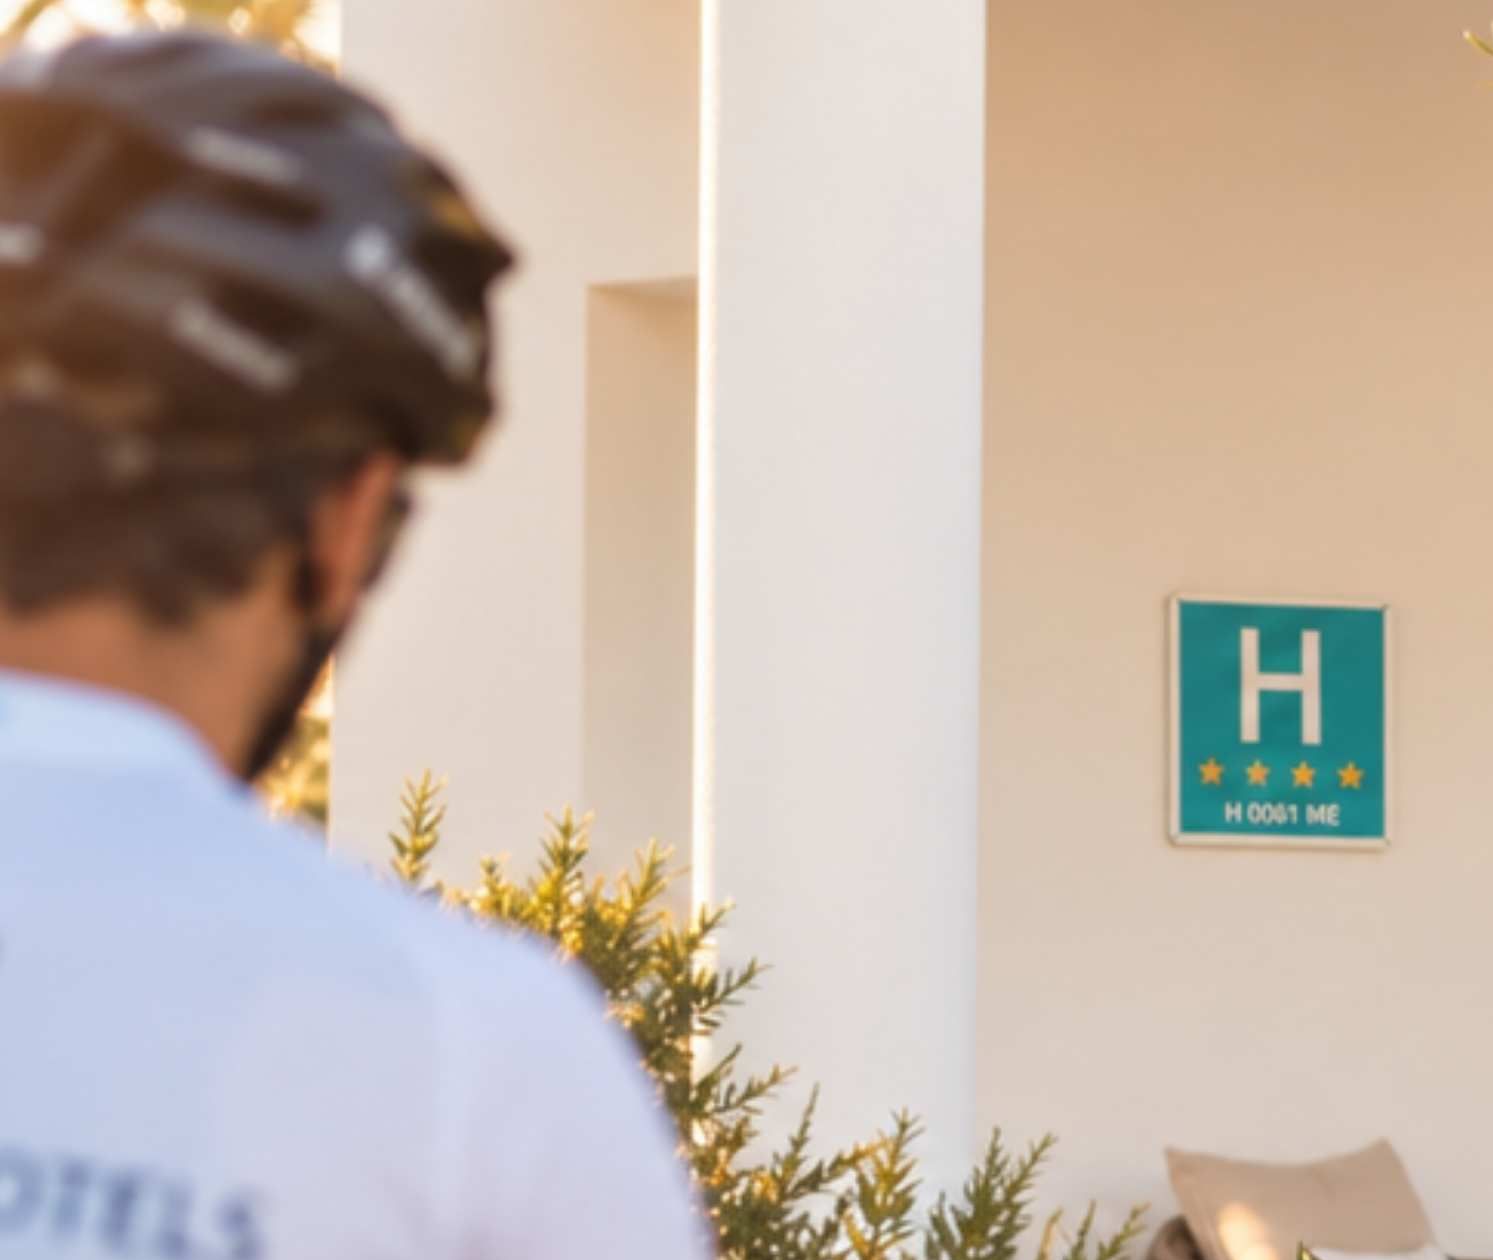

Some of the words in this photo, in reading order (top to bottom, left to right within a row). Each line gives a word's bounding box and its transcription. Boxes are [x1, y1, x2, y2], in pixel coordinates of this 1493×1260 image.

[1240, 627, 1322, 745] H
[1224, 801, 1243, 824] H
[1305, 803, 1341, 828] ME
